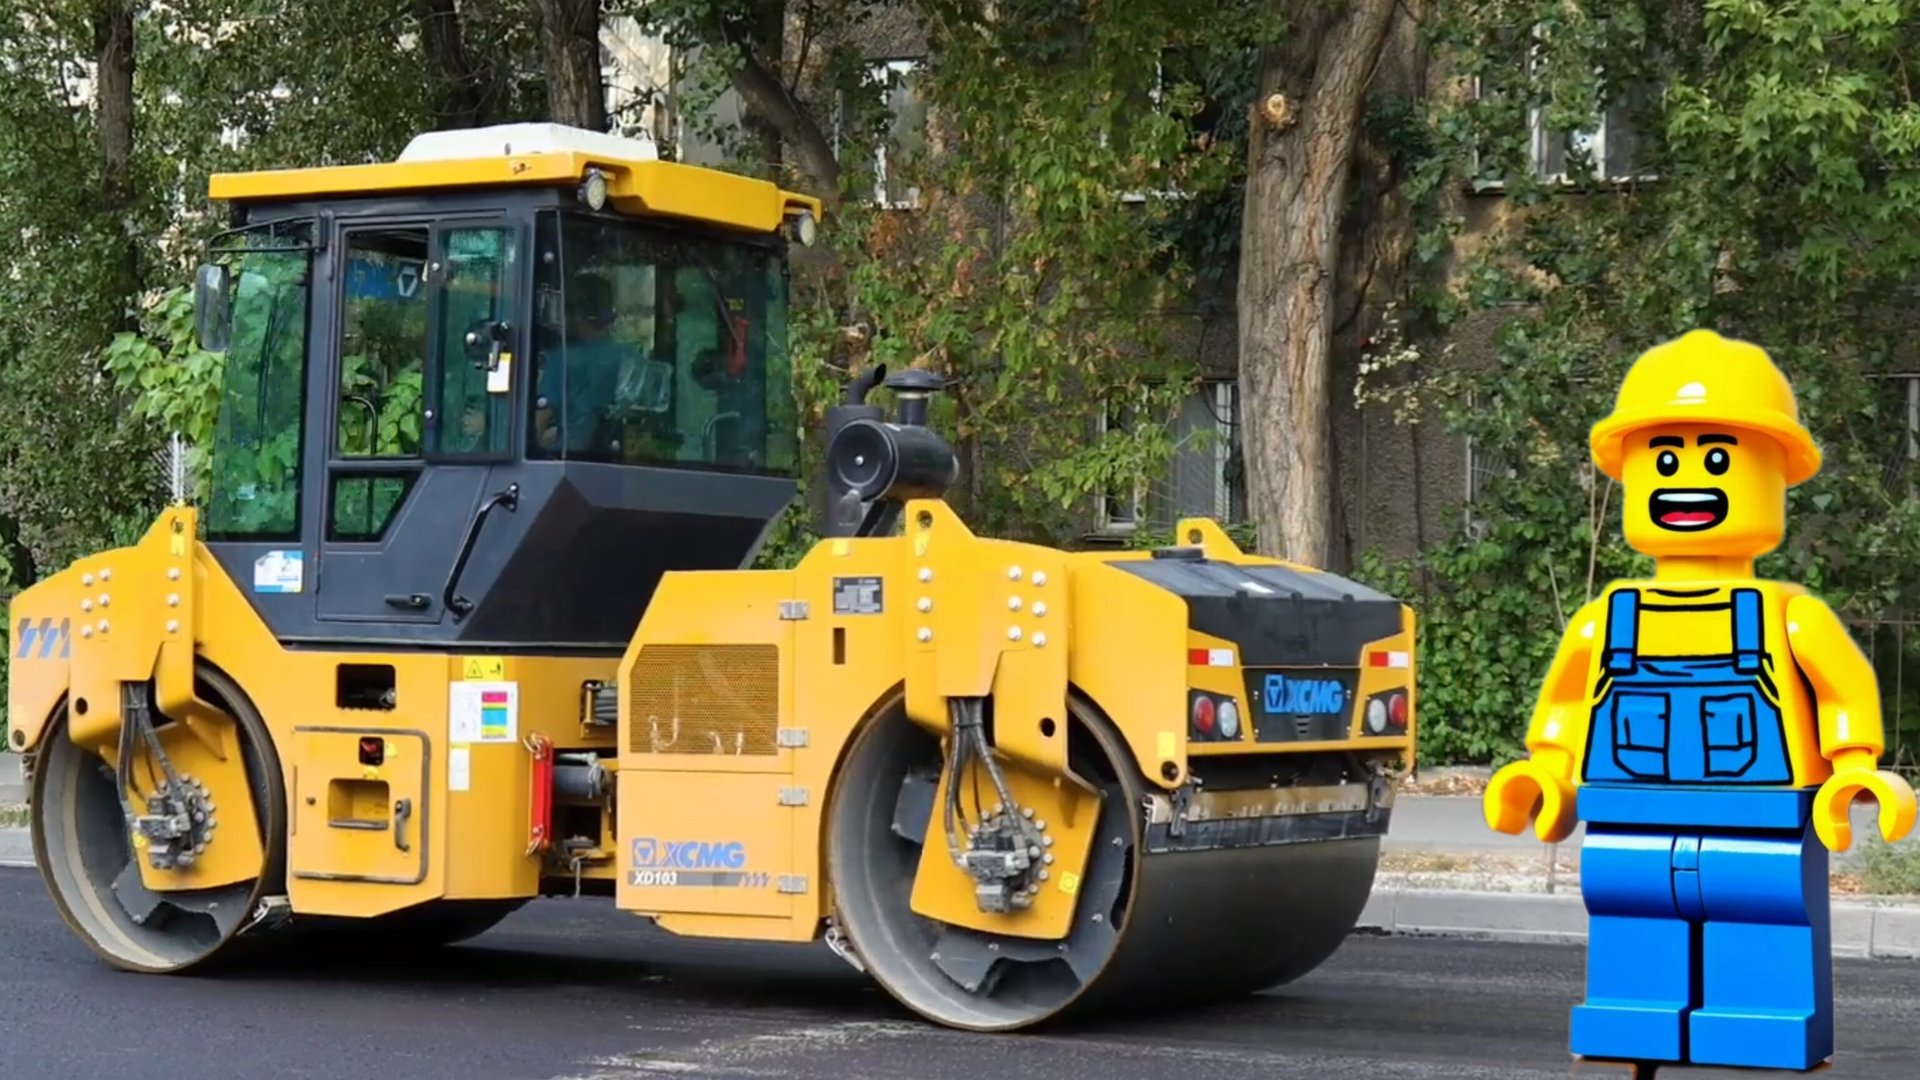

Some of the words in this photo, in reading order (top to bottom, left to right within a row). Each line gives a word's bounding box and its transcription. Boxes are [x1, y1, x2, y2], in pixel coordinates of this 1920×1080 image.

[1284, 679, 1343, 714] XCMG
[658, 841, 746, 869] XCMG
[633, 871, 679, 886] XD103
